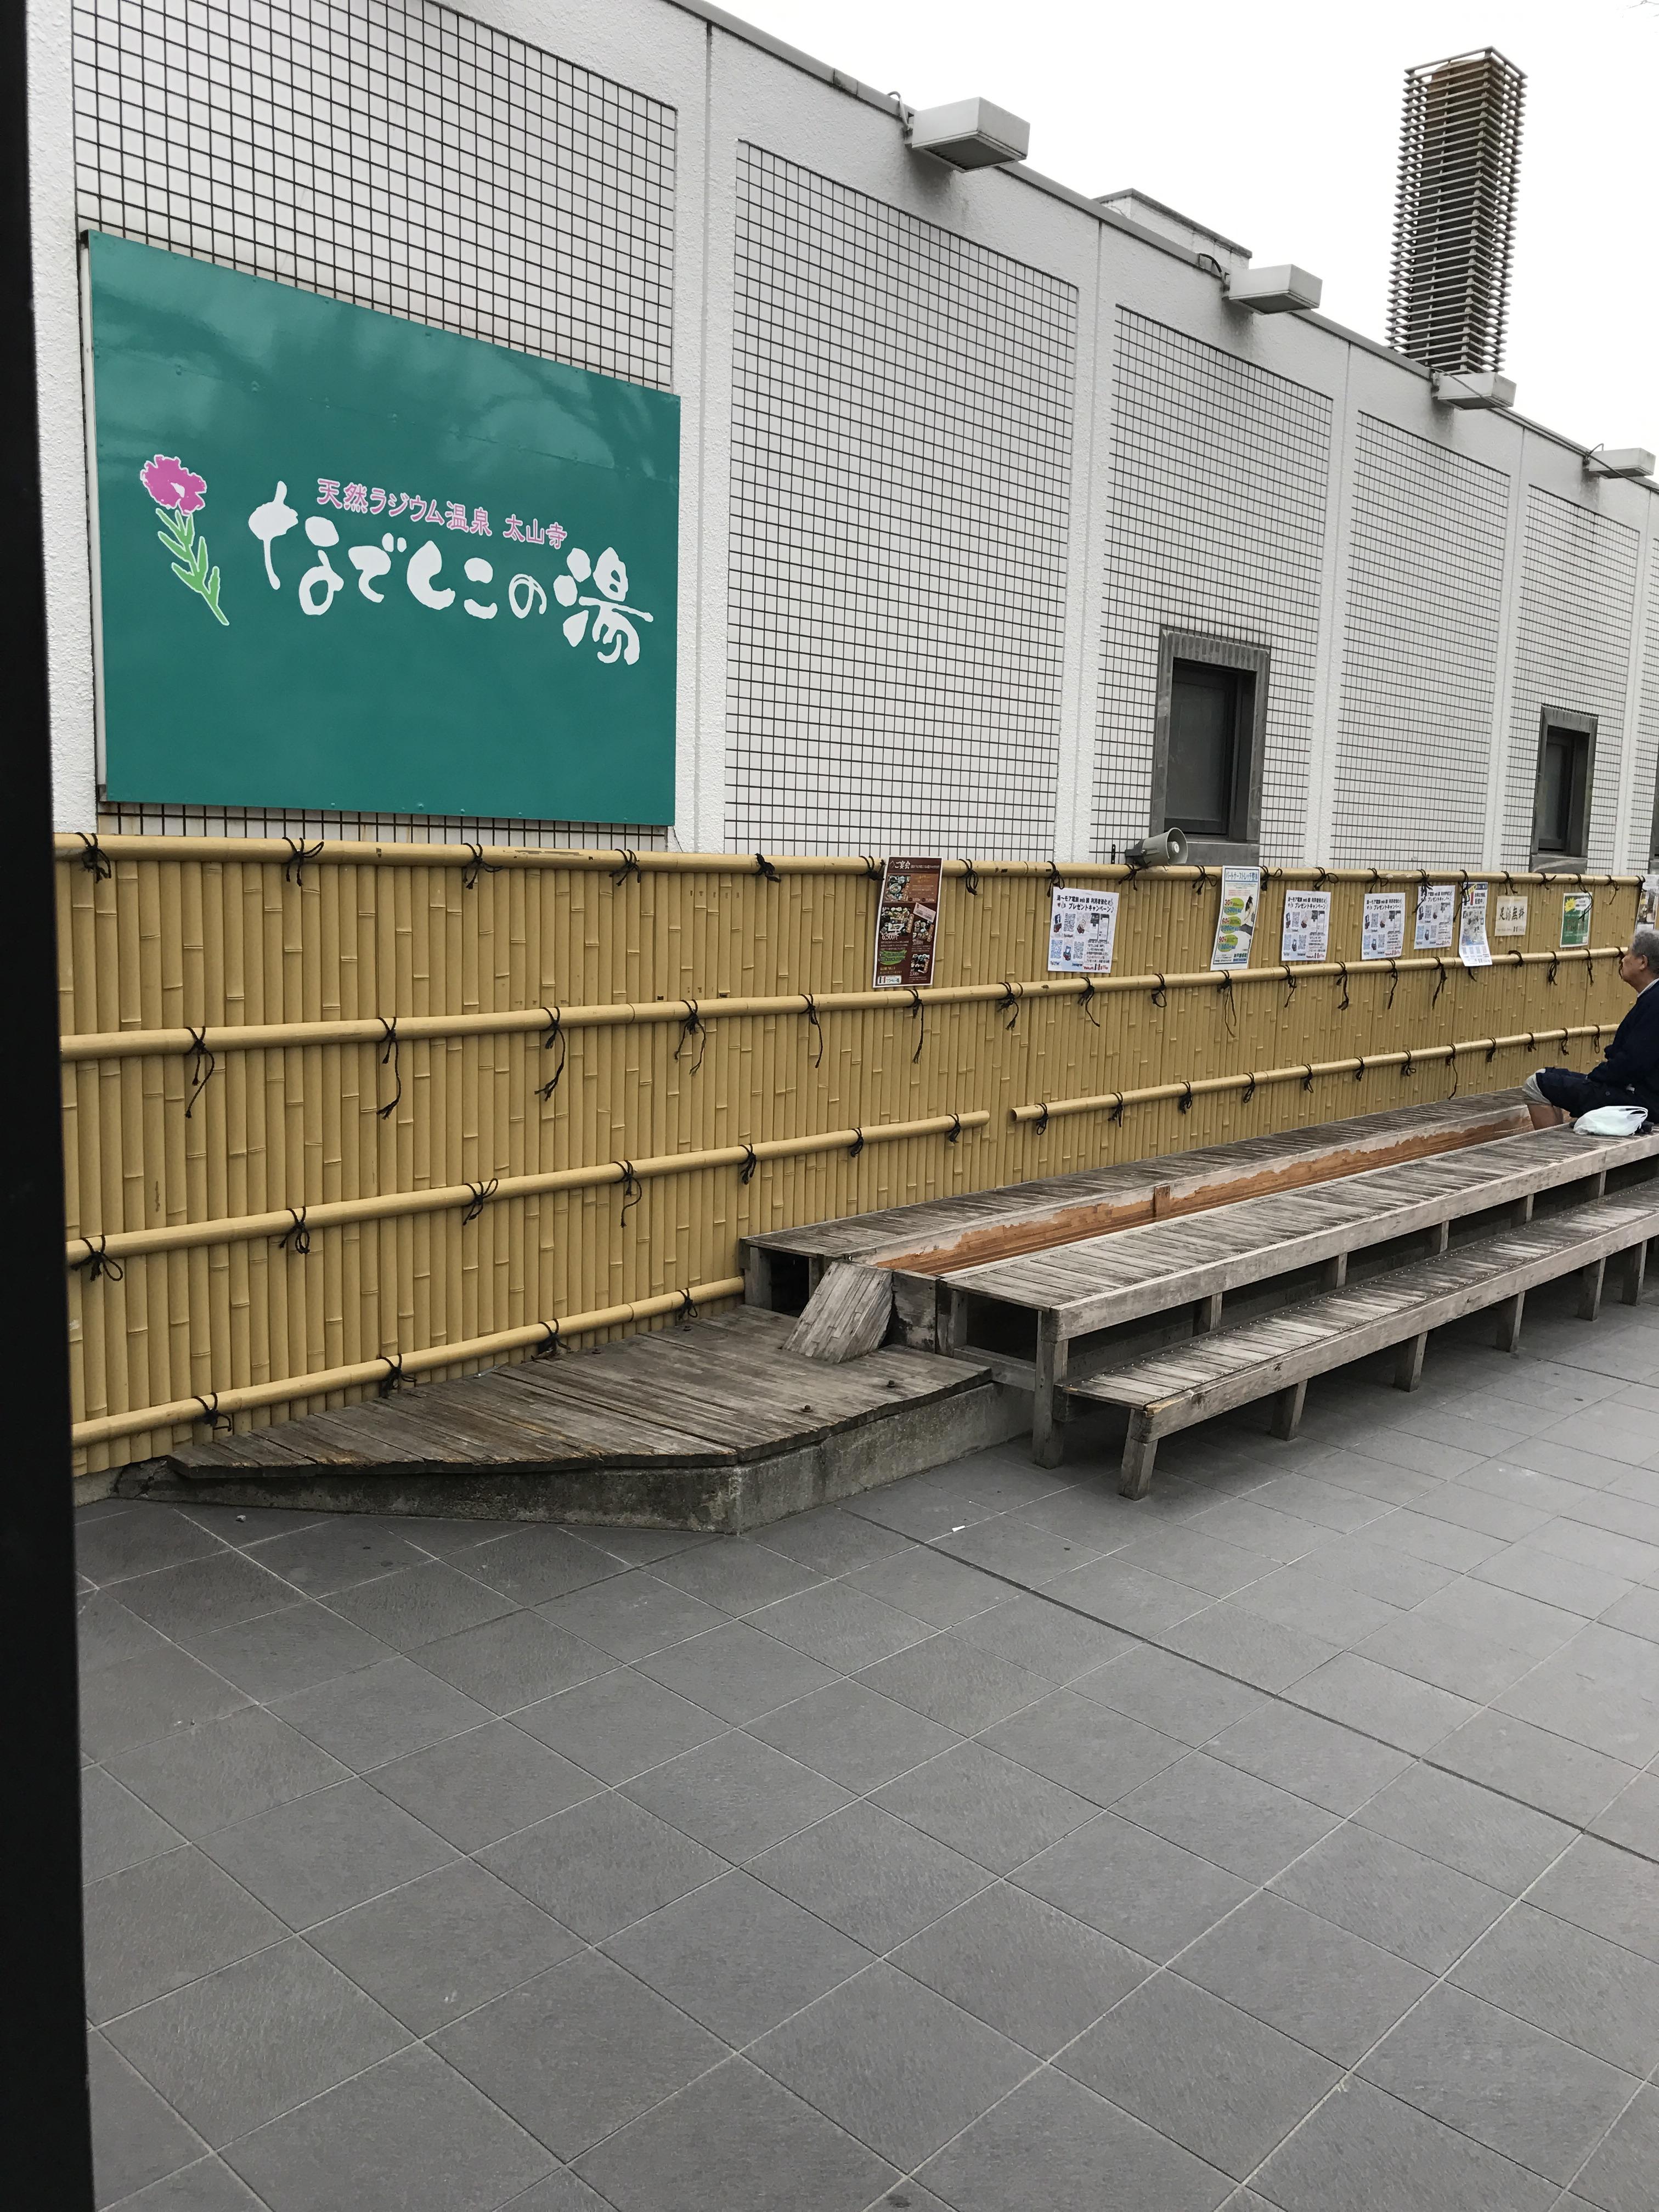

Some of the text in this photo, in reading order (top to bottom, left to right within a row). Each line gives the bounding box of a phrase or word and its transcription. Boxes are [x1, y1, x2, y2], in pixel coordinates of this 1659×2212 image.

[317, 477, 568, 549] 天然ラジウム温泉 太山寺
[248, 480, 654, 665] なでしこの湯
[1069, 903, 1111, 912] プレゼントキャンペーン
